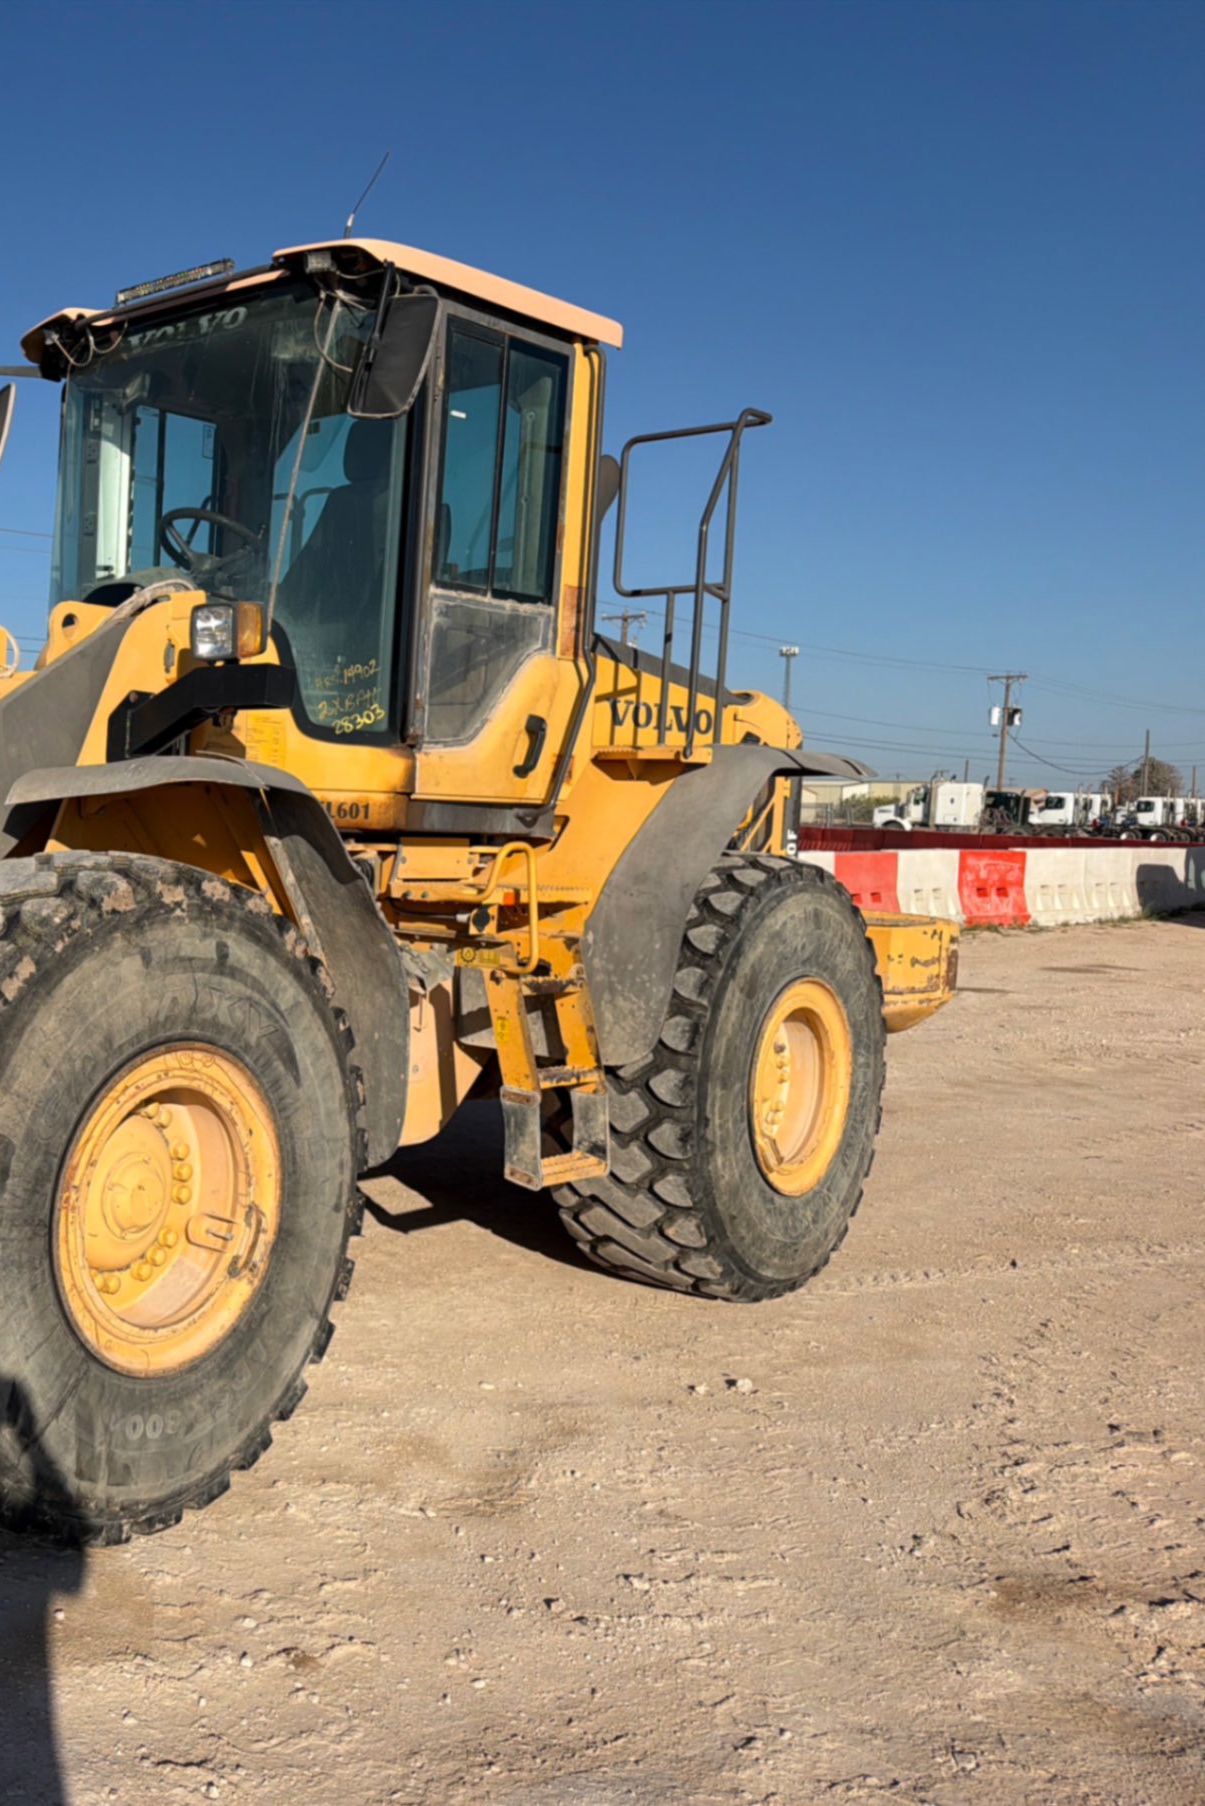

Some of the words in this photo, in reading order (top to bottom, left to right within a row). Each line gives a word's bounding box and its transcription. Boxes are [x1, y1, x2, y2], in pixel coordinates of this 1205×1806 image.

[331, 703, 386, 735] 28303
[607, 697, 712, 735] VOLVO
[321, 801, 370, 820] L601
